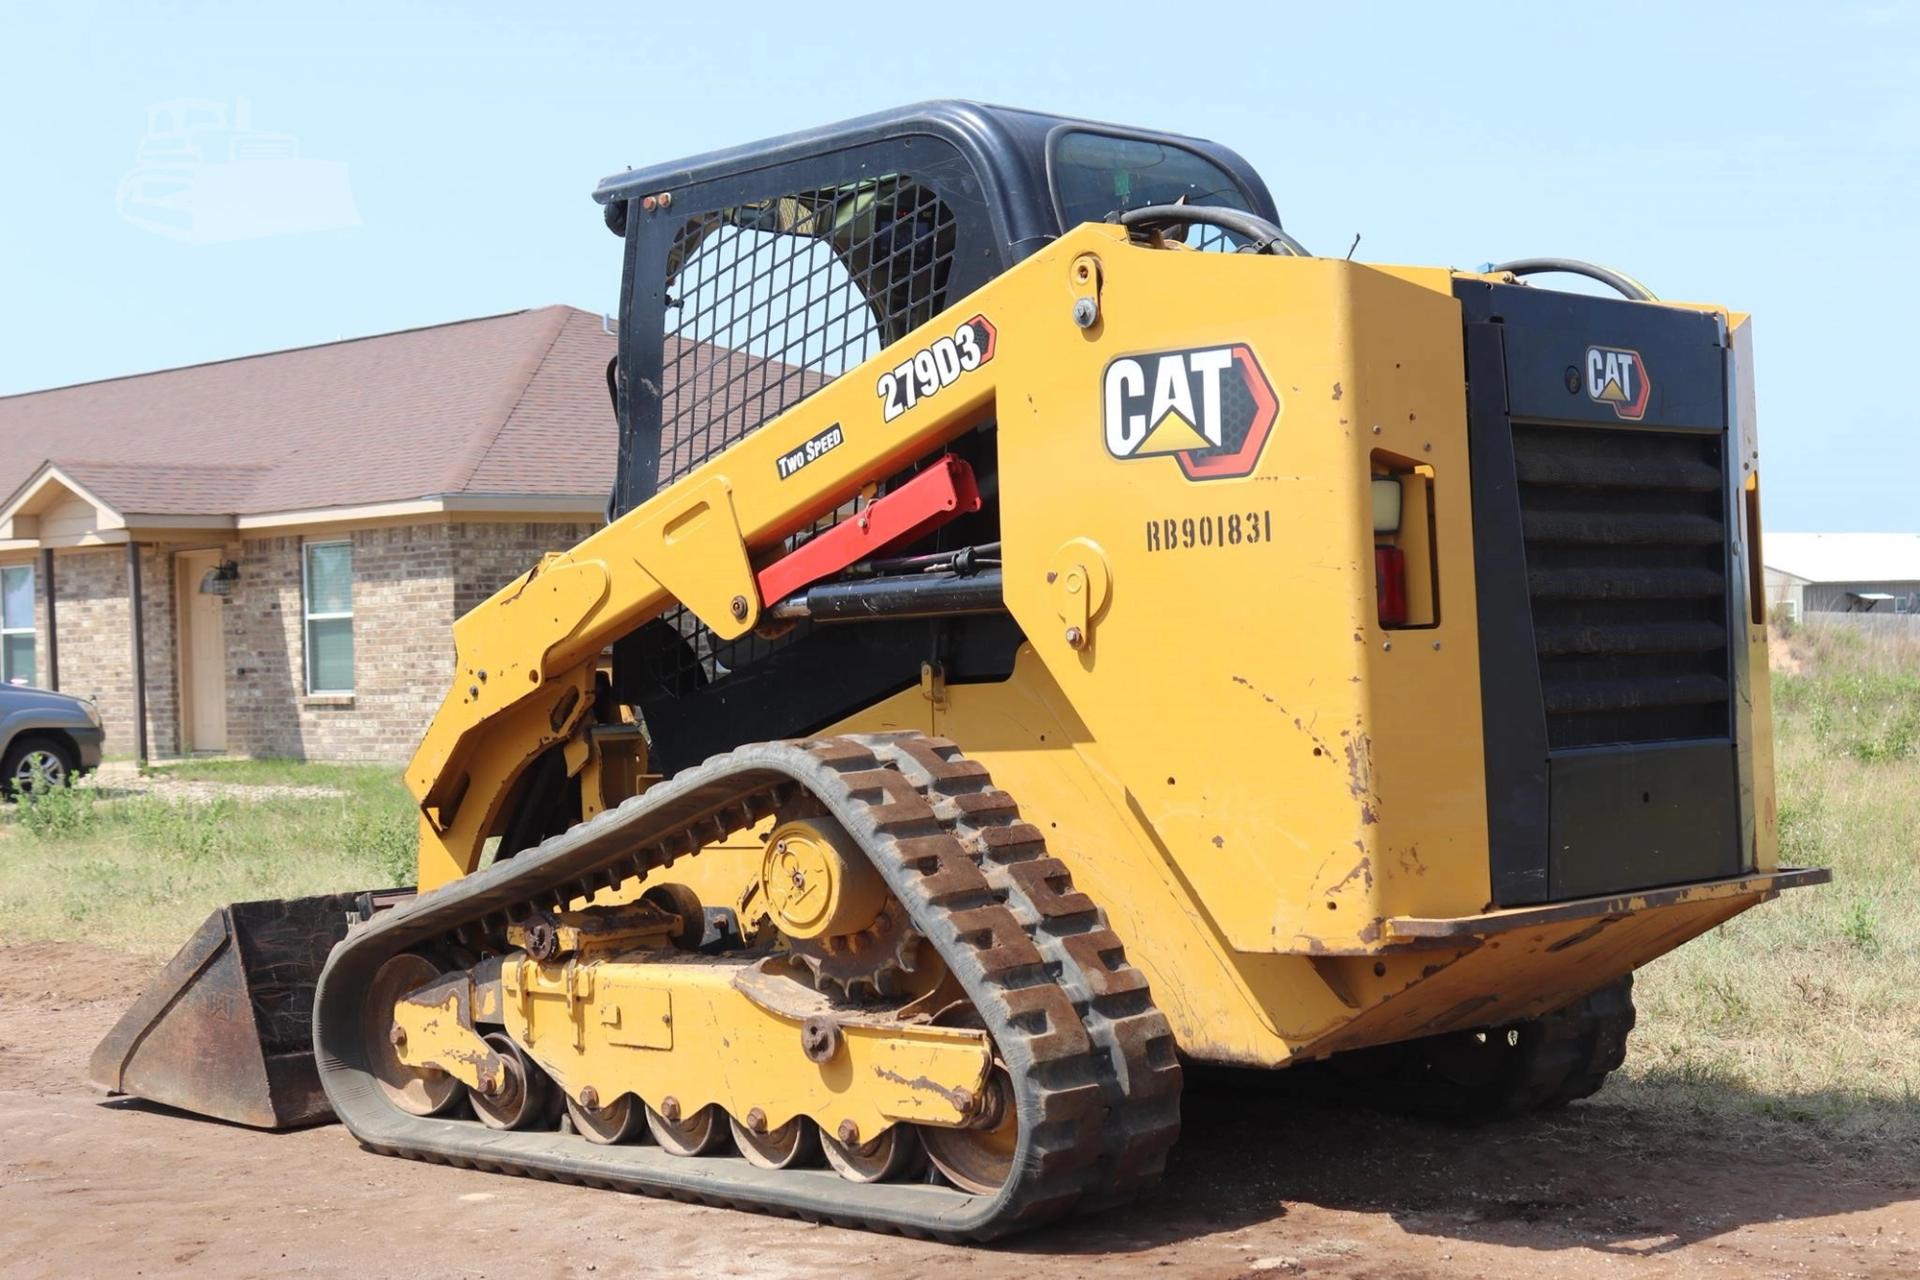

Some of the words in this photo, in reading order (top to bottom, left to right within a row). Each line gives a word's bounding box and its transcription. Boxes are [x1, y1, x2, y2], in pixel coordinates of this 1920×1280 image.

[877, 324, 982, 423] 279D3
[1105, 348, 1232, 456] CAT
[1588, 349, 1632, 401] CAT
[1147, 510, 1271, 552] RB901831
